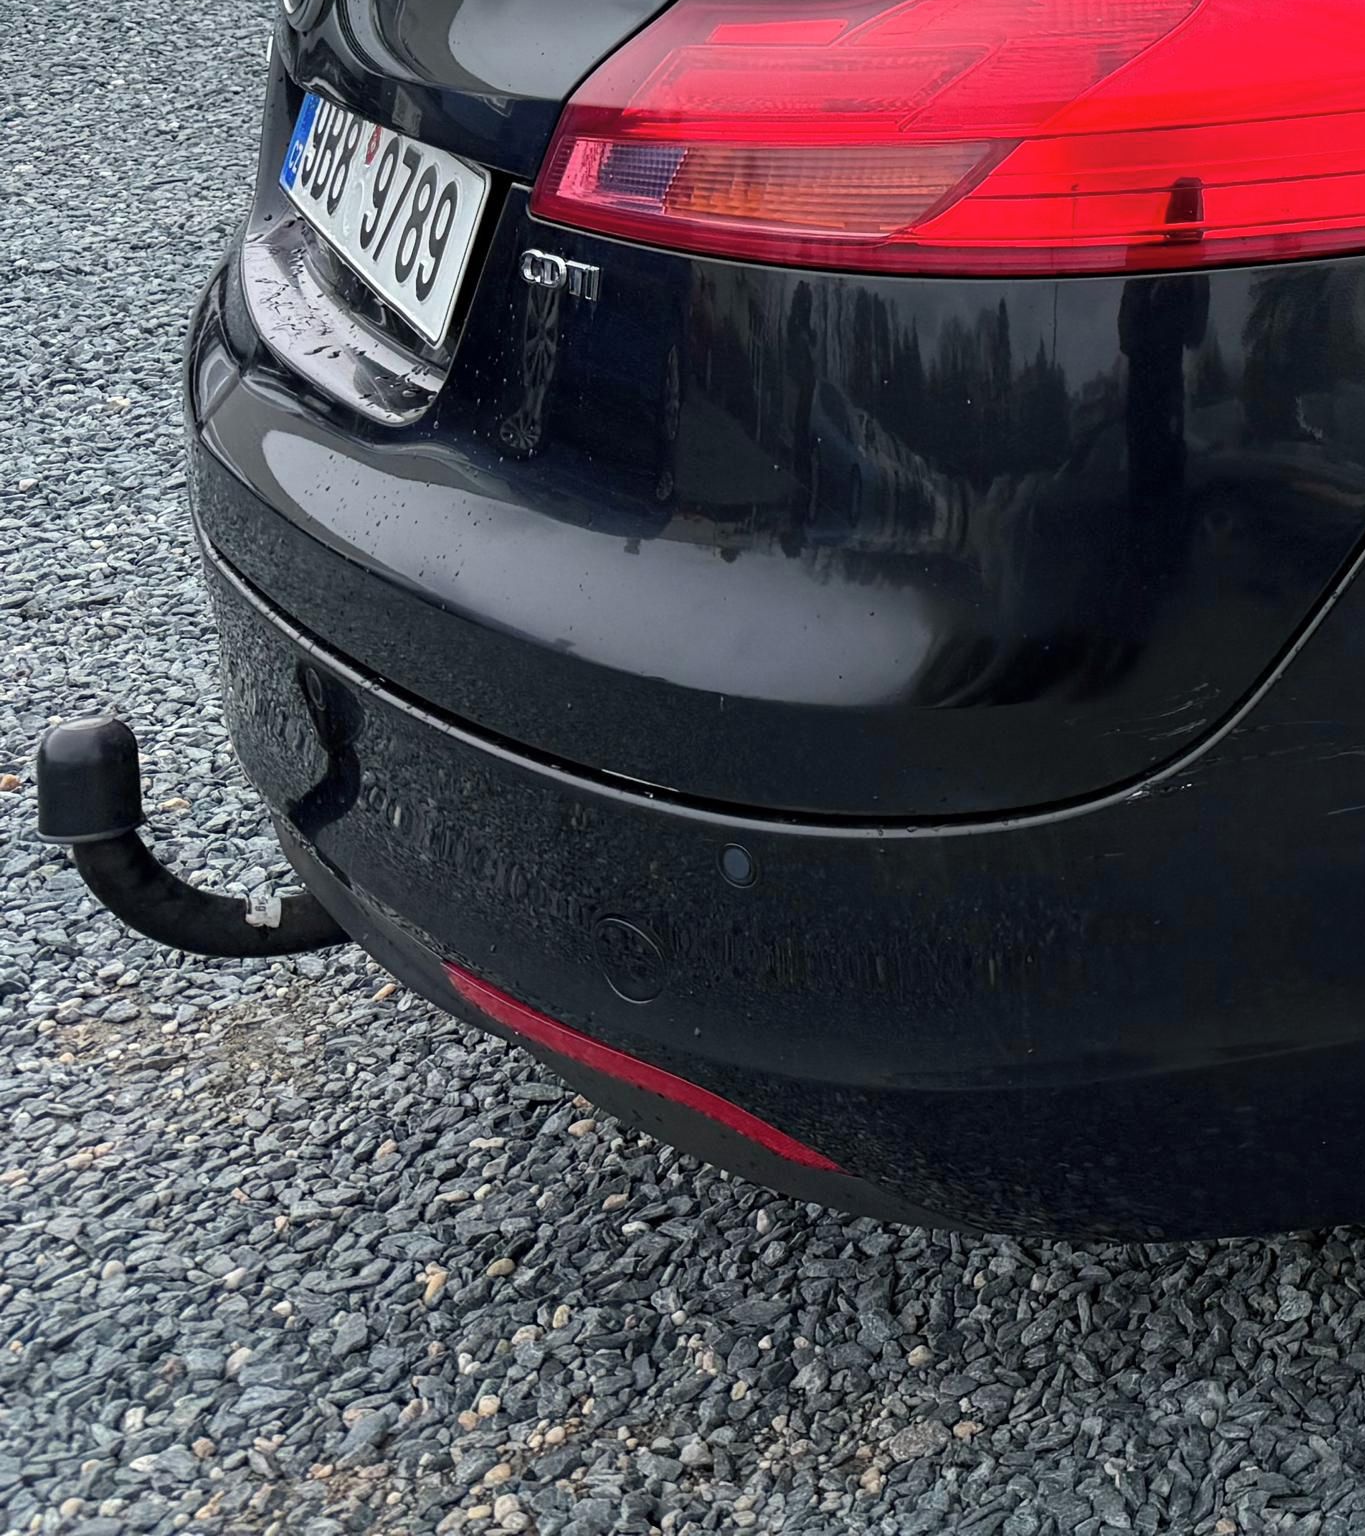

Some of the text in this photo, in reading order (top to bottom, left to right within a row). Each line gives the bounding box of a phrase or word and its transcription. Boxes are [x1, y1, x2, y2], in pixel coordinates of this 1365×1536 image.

[288, 139, 304, 175] CZ
[359, 135, 459, 302] 9789
[520, 248, 601, 302] CDTI
